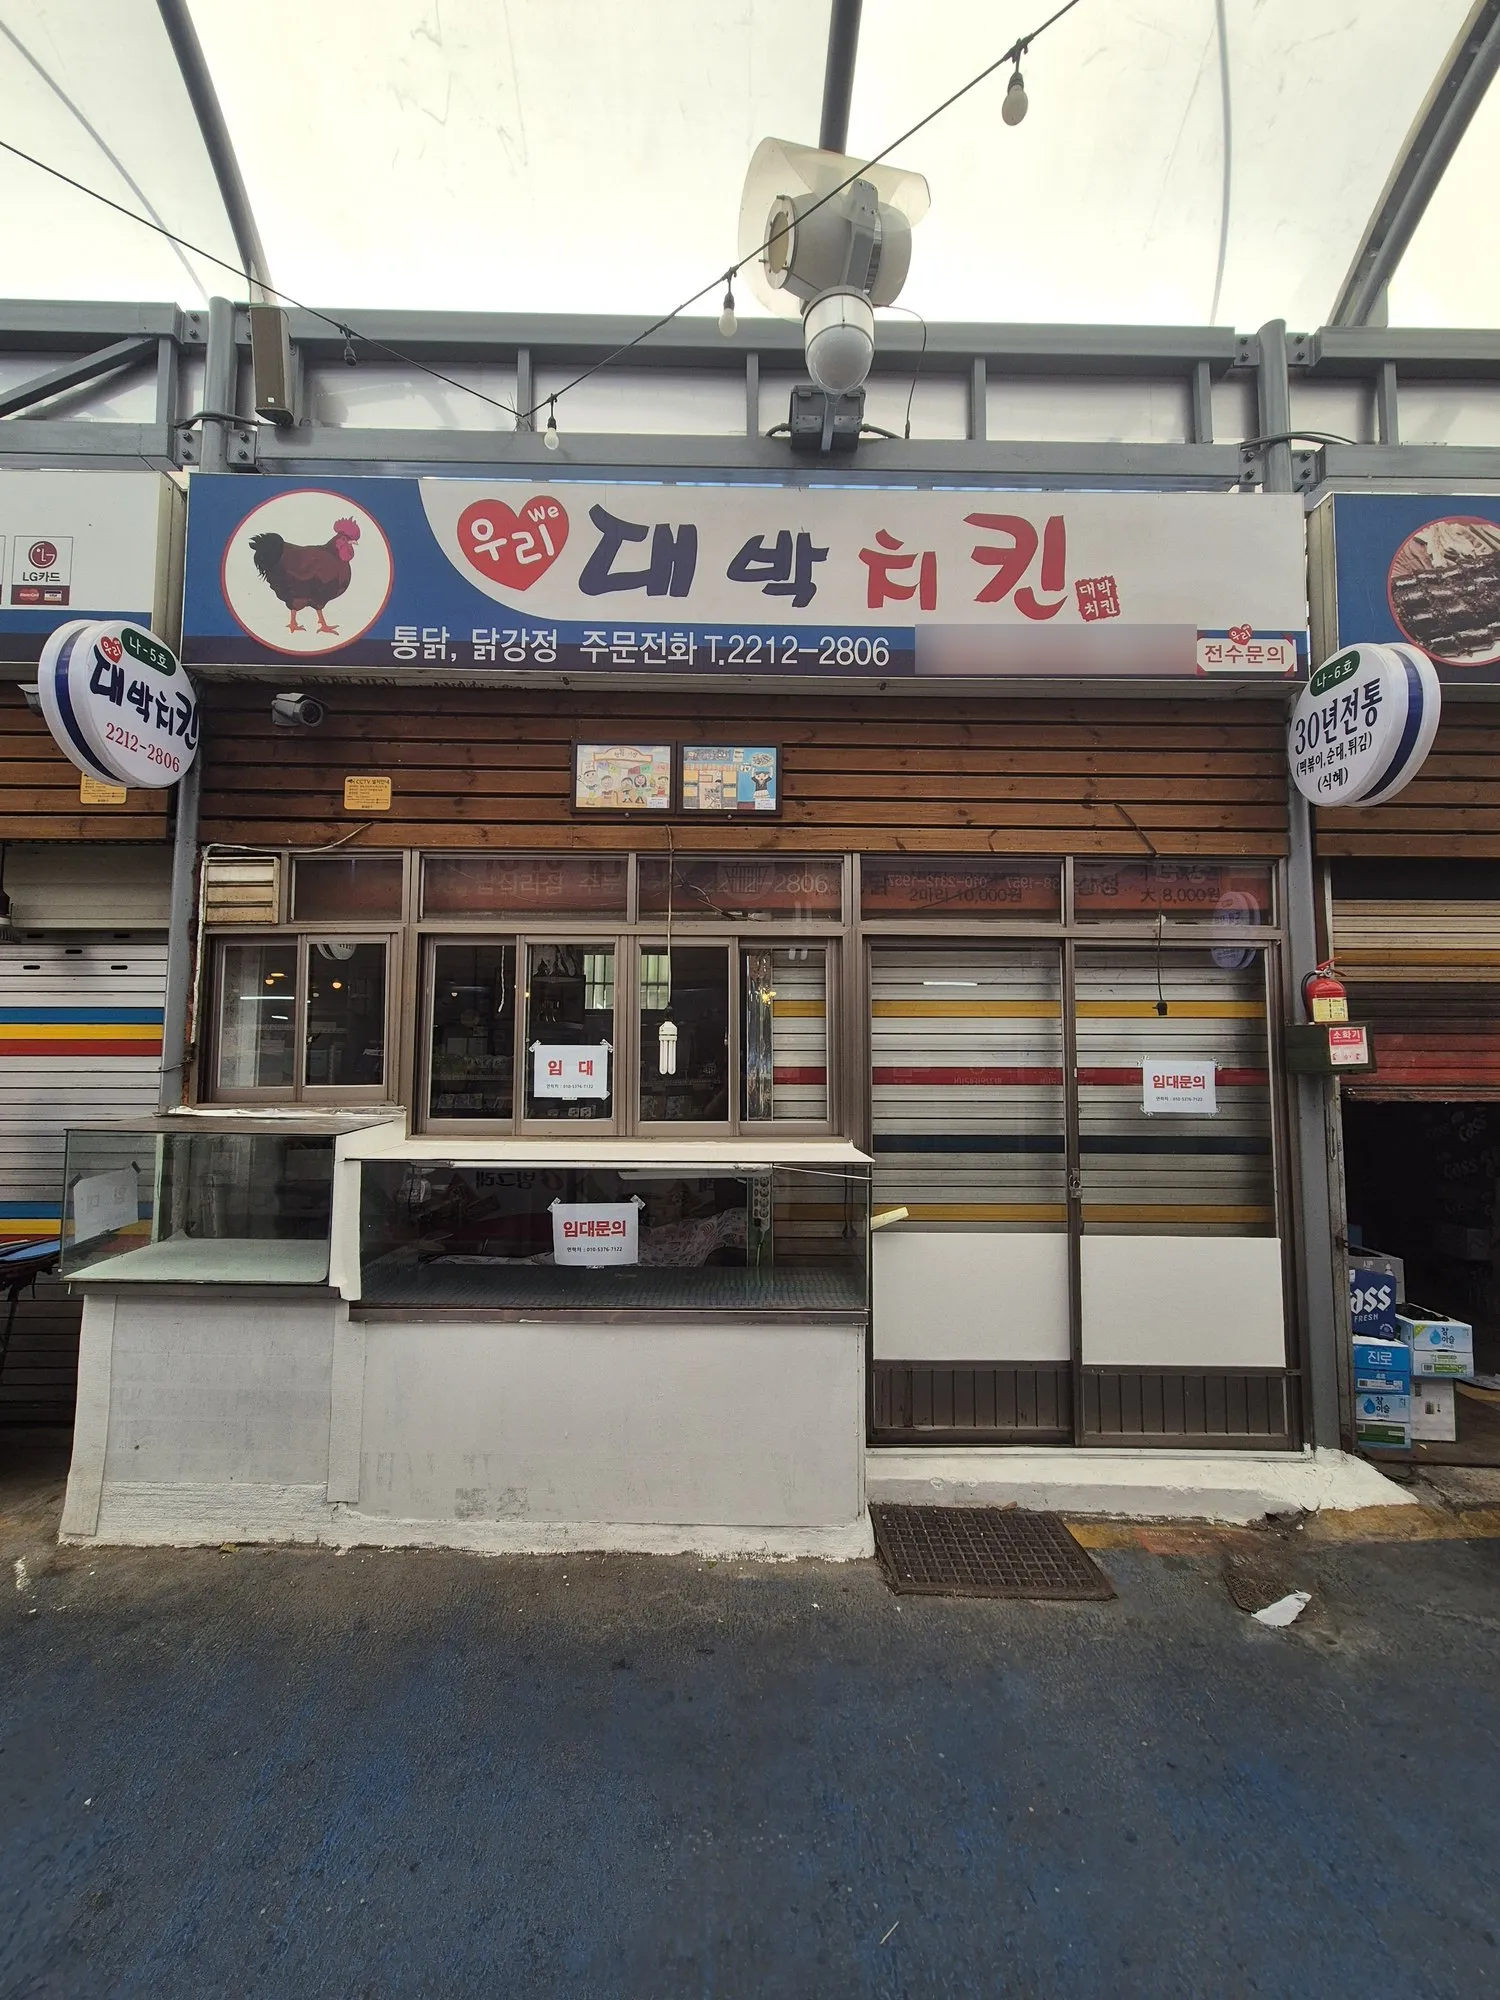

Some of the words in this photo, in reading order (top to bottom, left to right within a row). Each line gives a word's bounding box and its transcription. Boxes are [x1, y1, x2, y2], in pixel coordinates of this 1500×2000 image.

[527, 505, 559, 522] We
[470, 518, 555, 565] 우리
[578, 502, 1069, 621] 대박치킨
[22, 571, 61, 583] LG카드
[1079, 579, 1113, 598] 대박
[1083, 597, 1118, 617] 치킨
[1231, 629, 1252, 641] 우리
[103, 641, 121, 657] 우리
[129, 636, 168, 669] 나-5호
[389, 624, 457, 662] 통닭,
[471, 627, 558, 663] 닭강정
[579, 629, 697, 666] 주문전화
[703, 633, 890, 667] T.2212-2806
[1205, 644, 1285, 665] 전수문의
[1316, 660, 1353, 688] 나-6호
[89, 644, 199, 750] 대박치킨
[1295, 677, 1383, 755] 30년전통
[105, 722, 180, 773] 2212-2806
[1317, 766, 1349, 793] (식혜)
[1333, 1030, 1361, 1039] 소화기
[1152, 1075, 1206, 1090] 임대문의
[563, 1219, 627, 1238] 임대문의
[1350, 1284, 1392, 1315] ass
[1354, 1313, 1379, 1323] FRESH
[1367, 1350, 1393, 1366] 진로
